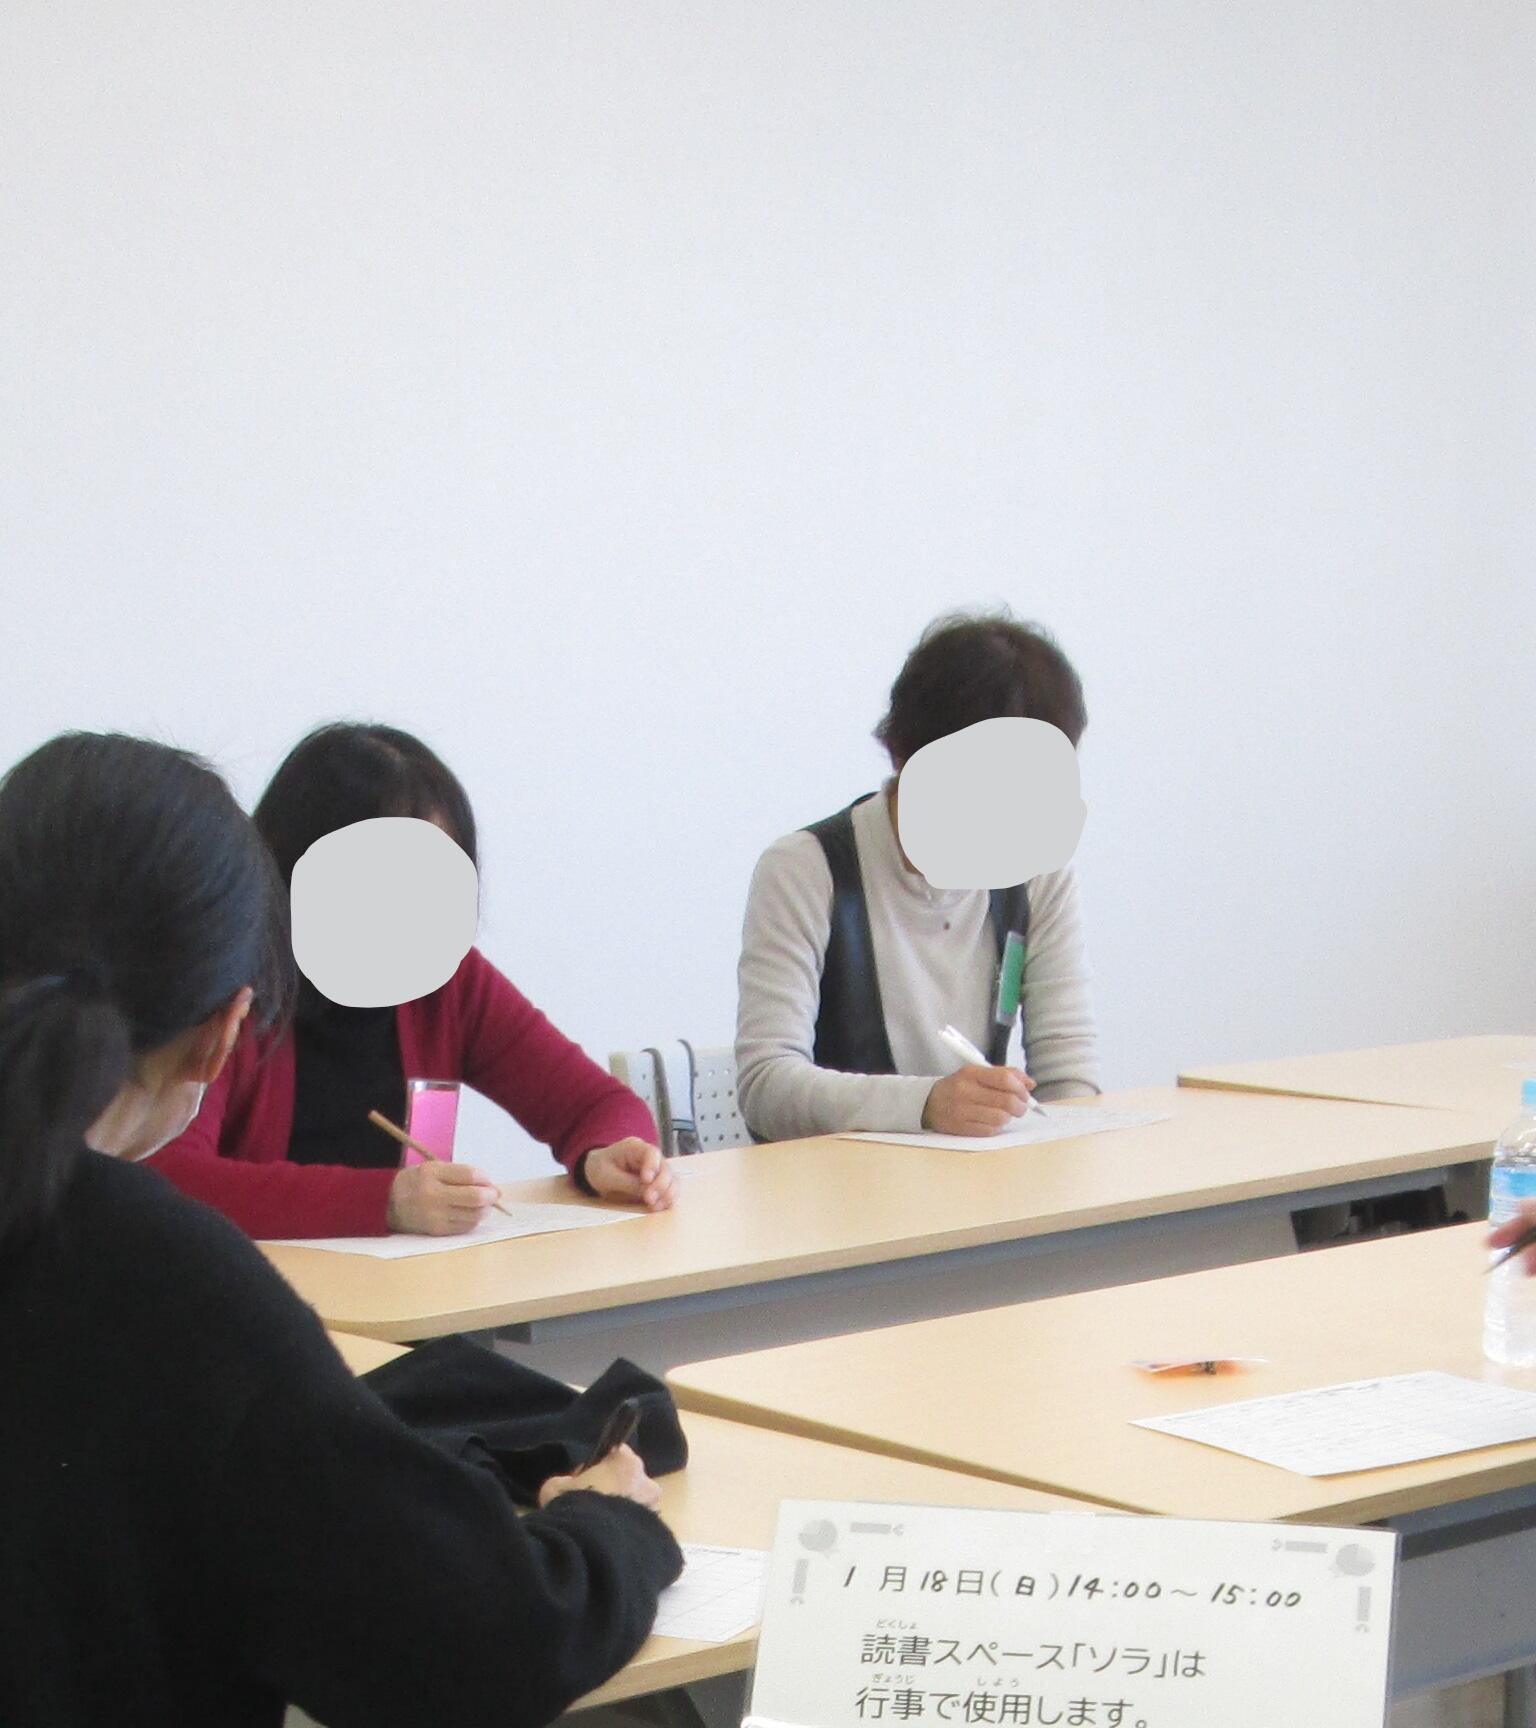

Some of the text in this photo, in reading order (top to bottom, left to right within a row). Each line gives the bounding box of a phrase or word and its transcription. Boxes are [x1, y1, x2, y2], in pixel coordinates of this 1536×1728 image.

[860, 1633, 1207, 1679] 読書スペース「ソラ」は
